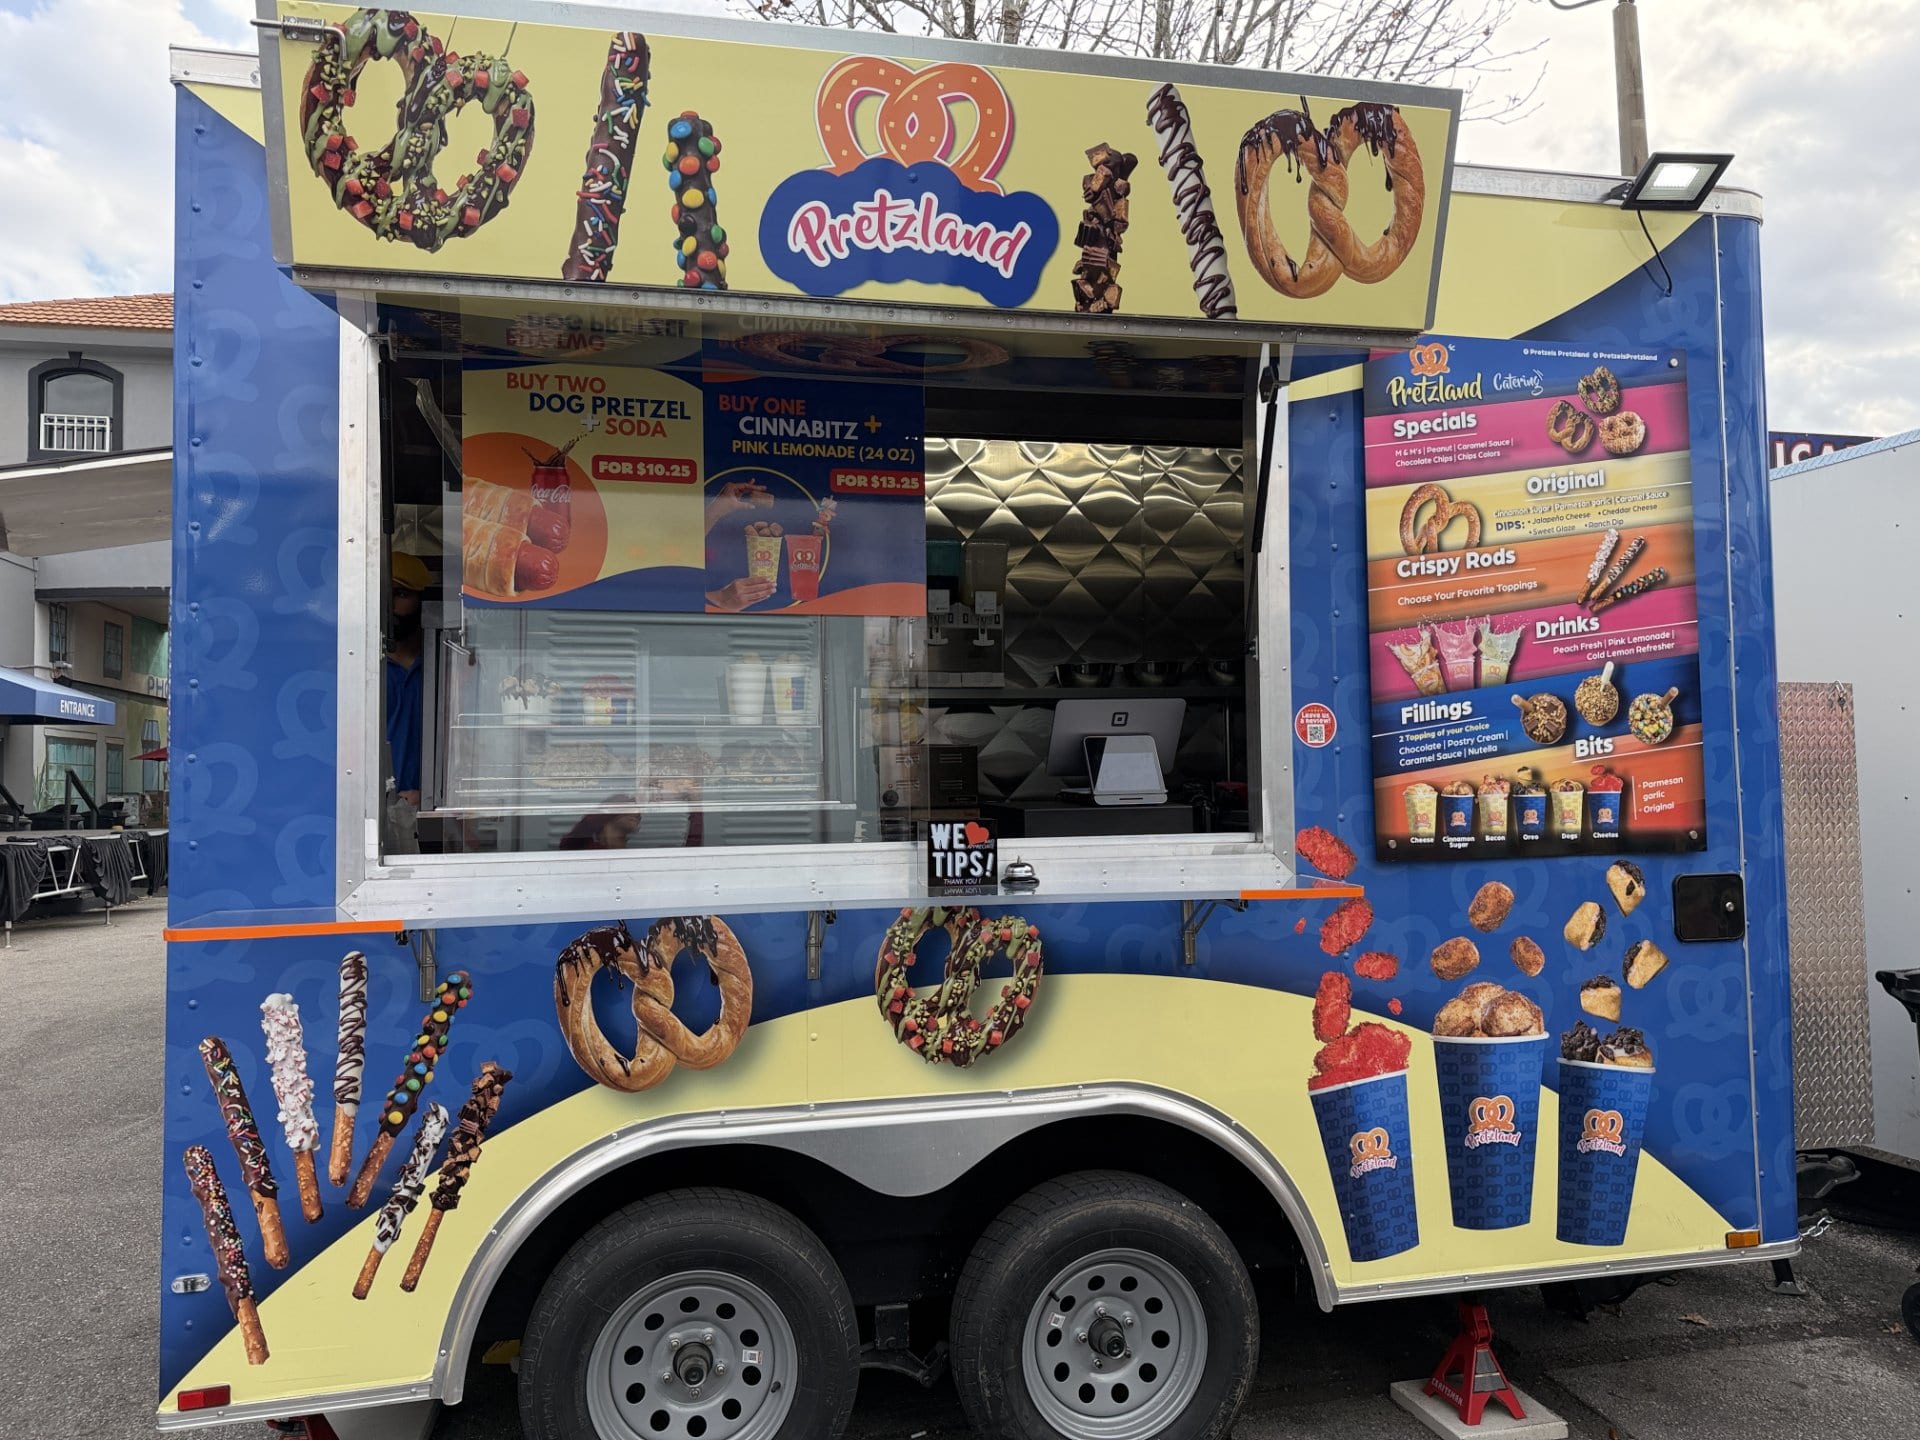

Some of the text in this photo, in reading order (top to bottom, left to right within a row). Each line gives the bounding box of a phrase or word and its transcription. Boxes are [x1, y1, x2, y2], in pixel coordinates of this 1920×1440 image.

[789, 190, 1030, 277] Pretzland
[507, 372, 606, 394] BUY TWO
[1386, 371, 1544, 406] Pretzland Catering
[529, 392, 691, 420] DOG PRETZEL
[719, 394, 806, 416] BUY ONE
[605, 418, 667, 438] SODA
[738, 415, 858, 440] CINNABITZ
[1393, 411, 1477, 439] Specials
[732, 440, 915, 464] PINK LEMONADE (24 OZ)
[1426, 443, 1453, 453] Peanut
[1457, 440, 1487, 451] Caramel
[1488, 439, 1510, 447] Sauce
[599, 461, 691, 477] FOR $10.25
[1395, 450, 1500, 467] Chocolate Chips Chips Colors
[836, 474, 919, 489] FOR $13.25
[1527, 469, 1604, 494] Original
[1555, 500, 1590, 511] Parmesan
[1615, 494, 1644, 504] Caramel
[1646, 490, 1667, 500] Sauce
[1495, 520, 1525, 531] DIPS:
[1566, 511, 1590, 520] Cheese
[1602, 506, 1631, 516] Cheddar
[1632, 503, 1658, 512] Cheese
[1533, 518, 1624, 535] Sweet Glaze Ranch Dip
[1397, 548, 1516, 577] Crispy Rods
[1398, 580, 1538, 605] Choose Your Favorite Toppings
[1536, 616, 1600, 638] Drinks
[1553, 632, 1670, 655] Peach Fresh Pink Lemonade
[1587, 641, 1675, 661] Cold Lemon Refresher
[60, 700, 95, 717] ENTRANCE
[1401, 701, 1473, 725] Fillings
[1399, 722, 1490, 743] 2 Topping of your Choice
[1399, 741, 1441, 755] Chocolate
[1477, 732, 1504, 743] Cream
[1575, 734, 1614, 757] Bits
[1399, 745, 1498, 766] Caramel Sauce Nutella
[1643, 776, 1683, 788] Parmesan
[1643, 791, 1665, 801] garlic
[1643, 802, 1674, 813] Original
[930, 823, 966, 849] WE
[1410, 836, 1434, 844] Cheese
[1442, 835, 1475, 843] Cinnamon
[1449, 841, 1468, 849] Sugar
[1523, 833, 1539, 841] Oreo
[932, 851, 994, 877] TIPS!
[944, 878, 964, 886] THANK
[1465, 1128, 1521, 1149] Pretzland
[1577, 1137, 1626, 1157] Pretzland
[1350, 1156, 1397, 1178] Pretzland
